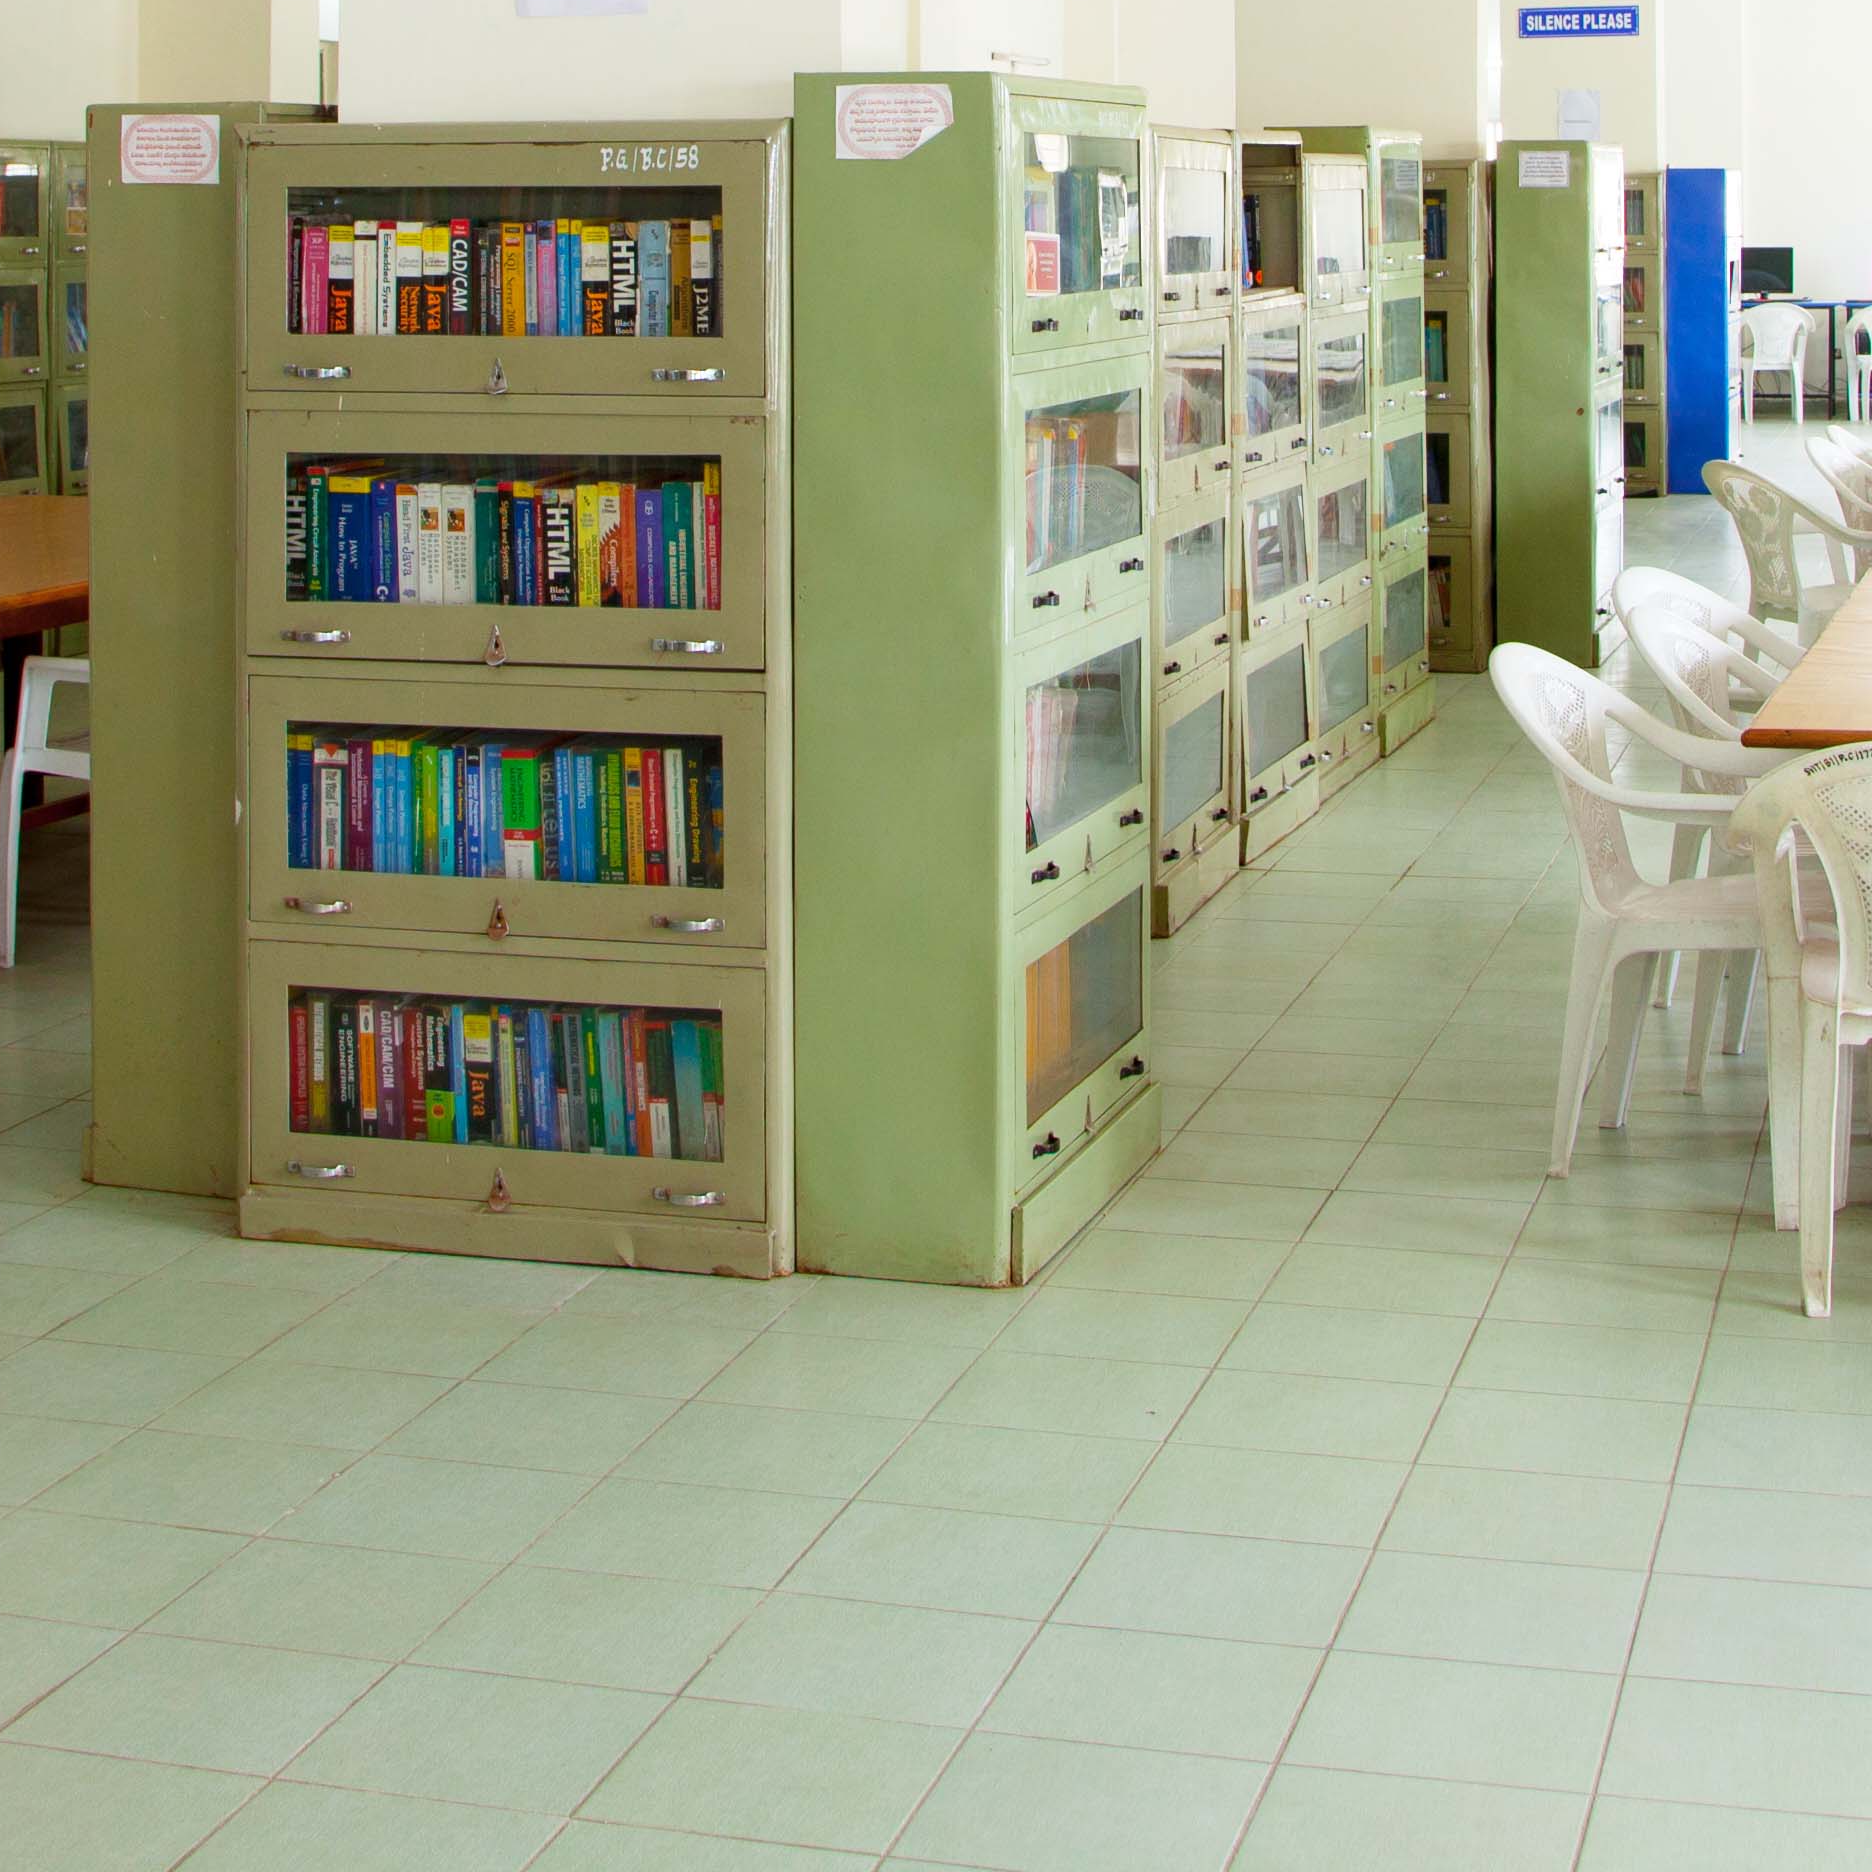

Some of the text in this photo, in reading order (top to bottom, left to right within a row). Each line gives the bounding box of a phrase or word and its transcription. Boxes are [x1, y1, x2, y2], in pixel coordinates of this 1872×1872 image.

[1526, 13, 1632, 31] SILENCE PLEASE
[381, 233, 392, 329] Embedded Systems
[451, 239, 468, 313] CAD/CAM
[505, 252, 518, 333] SQL Server 2000
[612, 240, 635, 313] HTML
[332, 285, 354, 332] Java
[398, 286, 410, 332] Security
[409, 285, 421, 332] Network
[423, 284, 449, 332] Java
[586, 288, 608, 335] Java
[647, 290, 659, 321] Computer
[693, 285, 709, 335] J2ME
[286, 495, 307, 565] HTML
[311, 488, 320, 577] Engineering Circuit Analysis
[401, 499, 414, 577] Head First Java
[500, 500, 509, 530] Signals
[523, 508, 531, 537] Computer
[335, 516, 346, 592] How to Program
[382, 511, 392, 584] Computer Science
[500, 545, 510, 580] Systems
[546, 507, 571, 581] HTML
[607, 539, 619, 587] Compilers
[645, 527, 653, 564] COMPUTER
[577, 756, 586, 809] MATHEMATICS
[688, 777, 701, 864] Engineering Drawing
[338, 1029, 347, 1102] ENGINEERING
[346, 1029, 355, 1083] SOFTWARE
[380, 1010, 395, 1088] CAD/CAM/CIM
[415, 1012, 425, 1091] Control Systems
[426, 1015, 434, 1072] Mathematics
[435, 1016, 446, 1067] Engineering
[468, 1070, 490, 1119] Java
